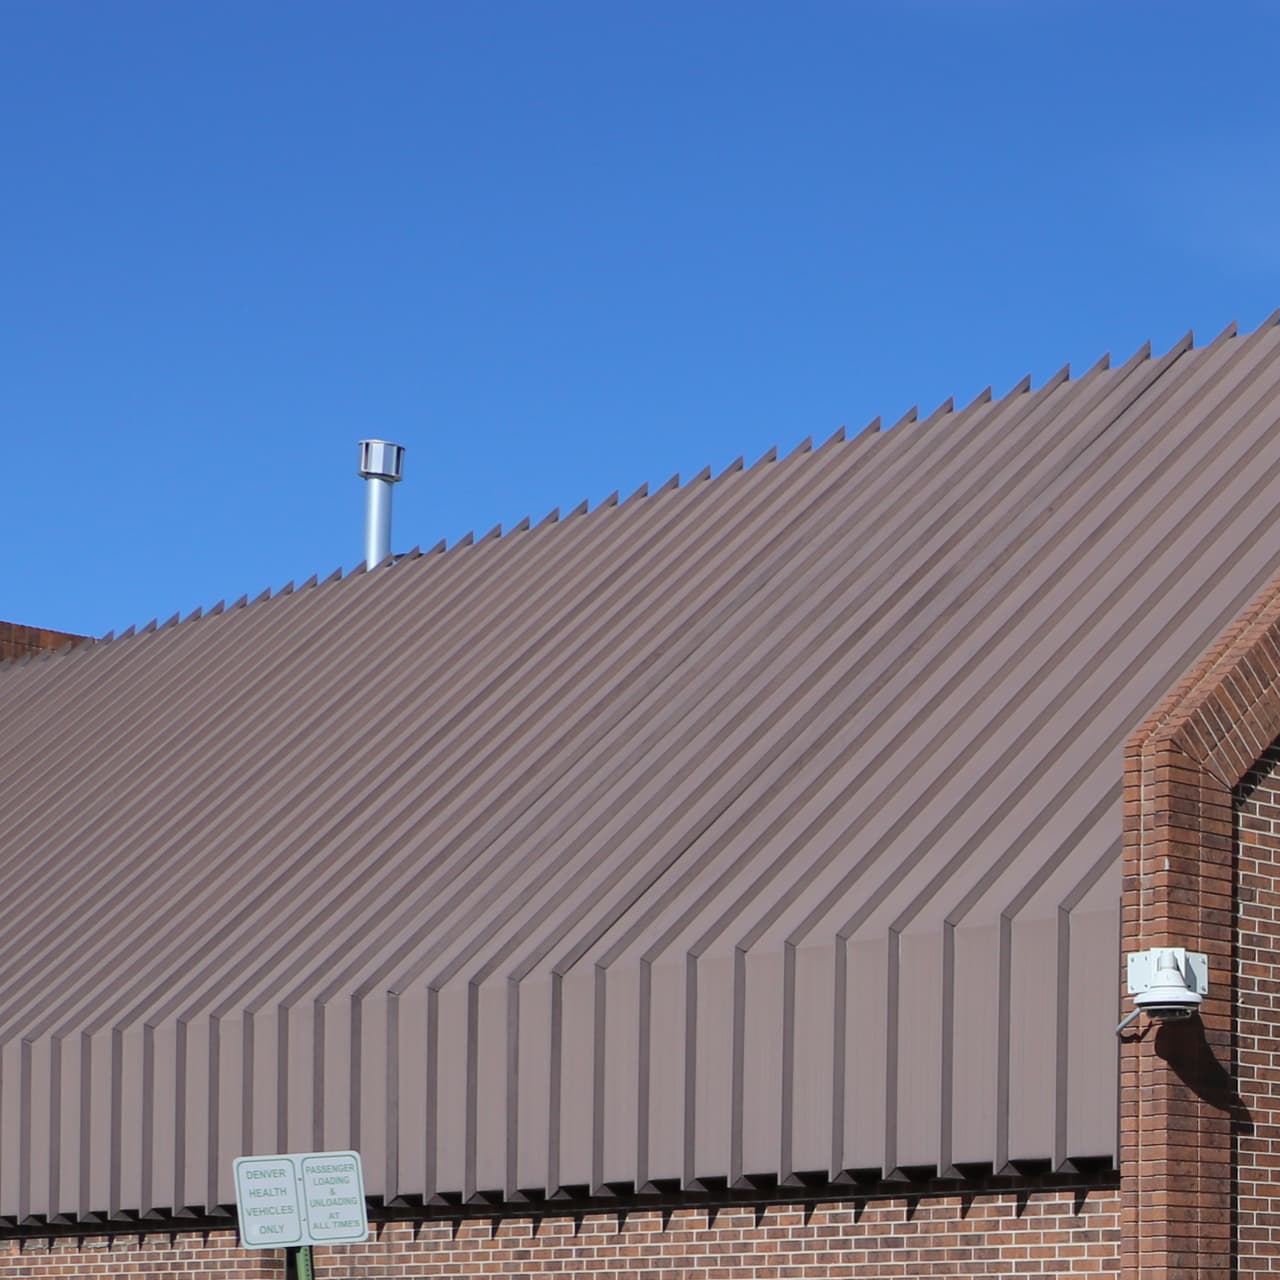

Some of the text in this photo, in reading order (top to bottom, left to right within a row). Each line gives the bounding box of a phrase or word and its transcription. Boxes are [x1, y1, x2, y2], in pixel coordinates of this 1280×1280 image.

[246, 1168, 286, 1180] DENVER
[305, 1163, 355, 1174] PASSENGER
[313, 1176, 350, 1186] LOADING
[249, 1187, 287, 1198] HEALTH
[310, 1197, 358, 1208] UNLOADING
[245, 1205, 294, 1217] VEHICLES
[329, 1211, 340, 1220] AT
[259, 1224, 285, 1234] ONLY
[312, 1219, 360, 1230] ALL TIMES
